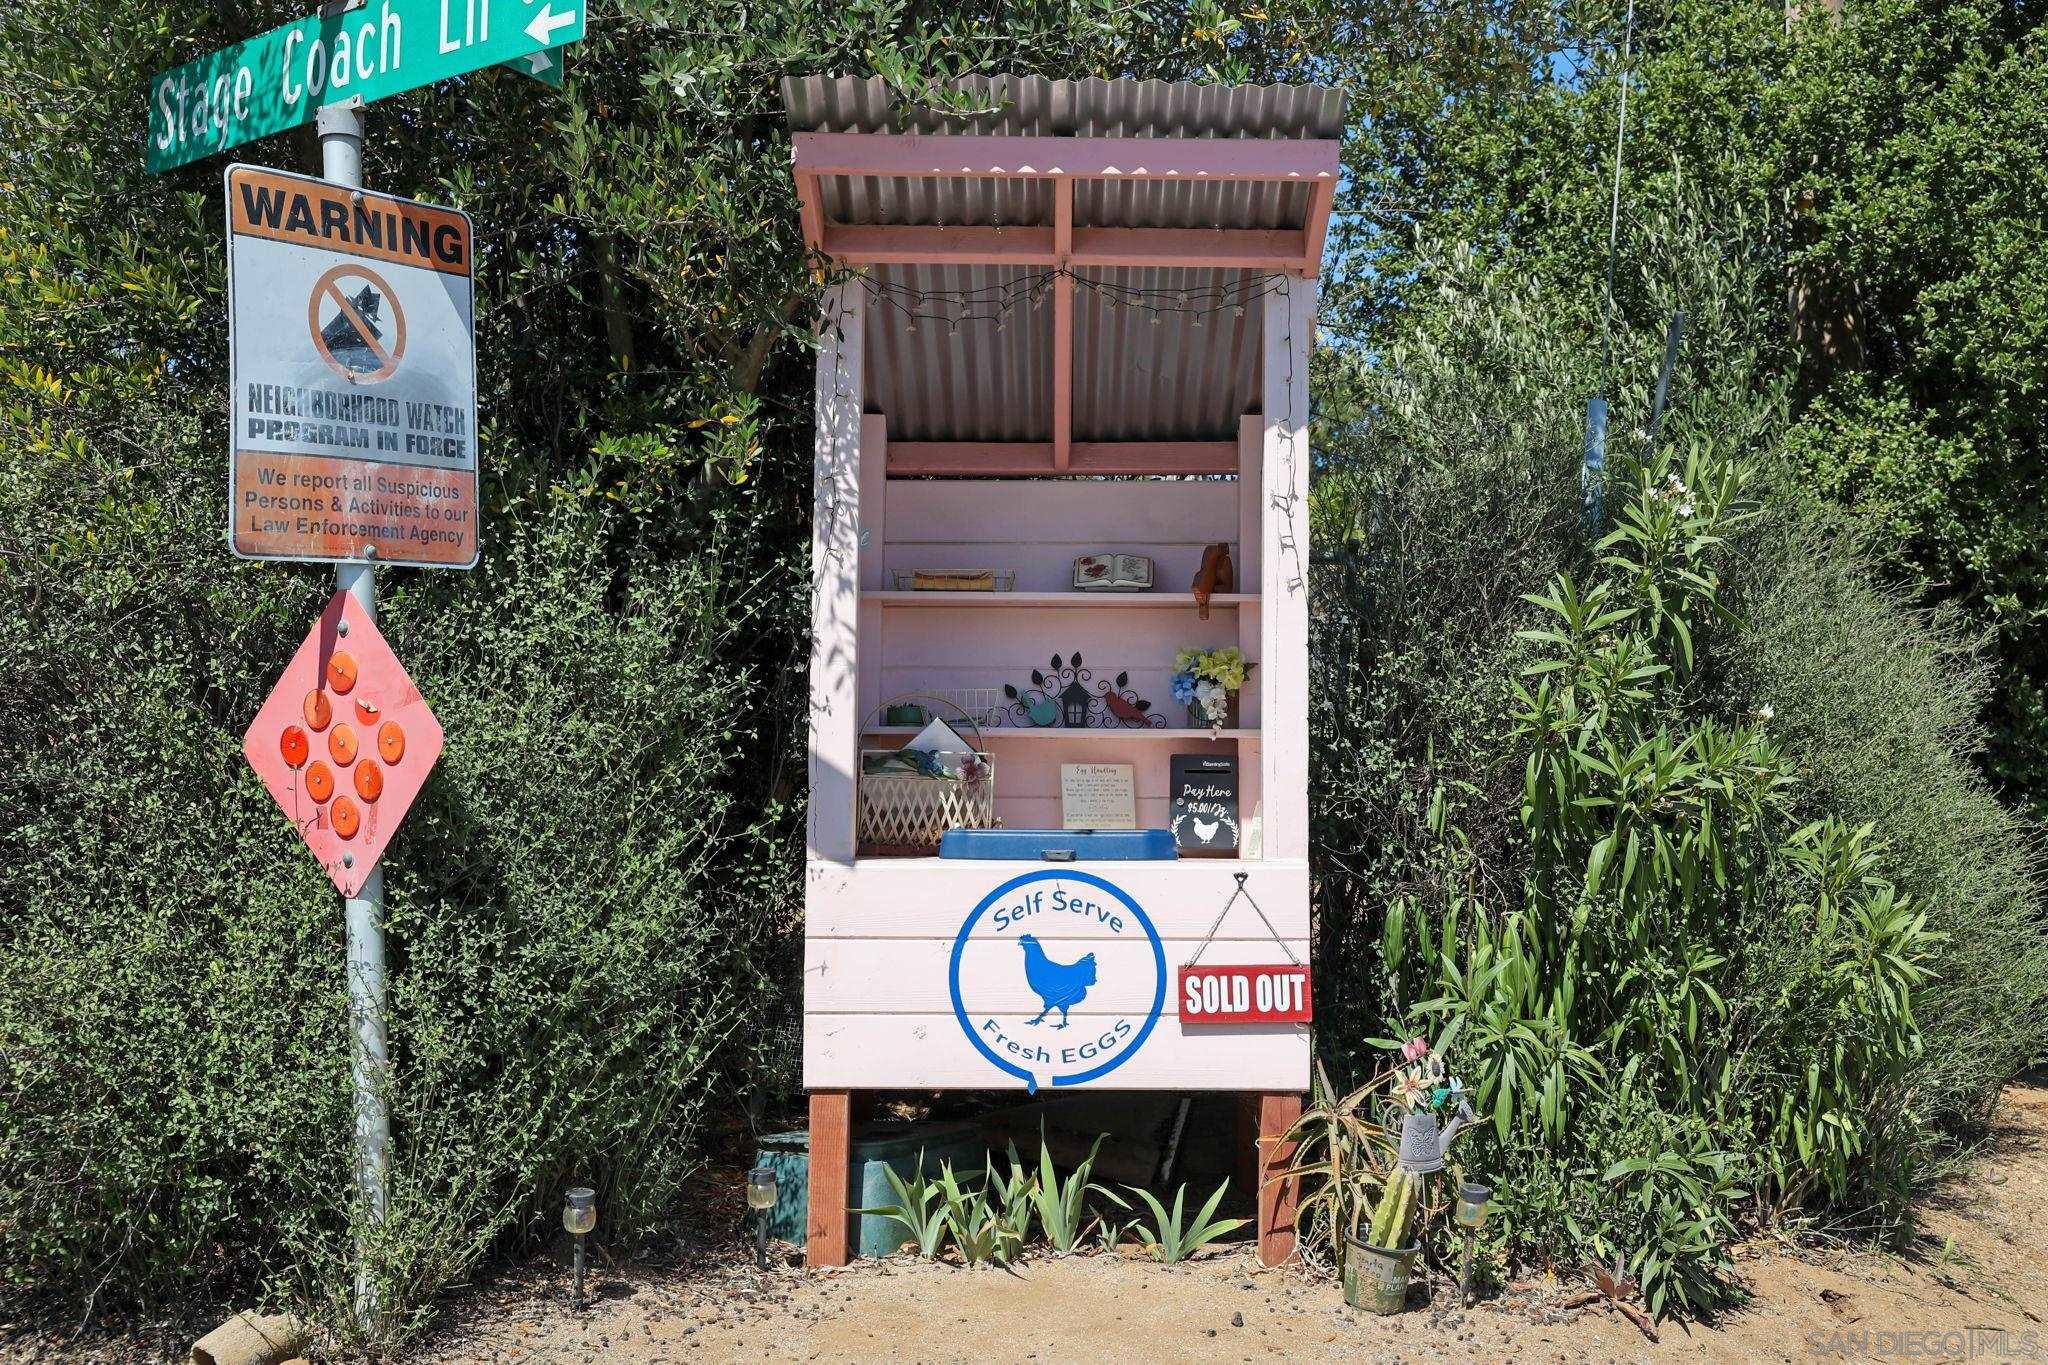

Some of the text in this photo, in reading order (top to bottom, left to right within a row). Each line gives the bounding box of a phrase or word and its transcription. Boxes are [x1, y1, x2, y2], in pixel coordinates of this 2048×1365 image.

[157, 65, 252, 150] Stage
[282, 1, 403, 105] Coach
[240, 182, 463, 265] WARNING
[248, 382, 466, 436] NEIGHBORHOOD WATCH
[248, 417, 467, 459] PROGRAM IN FORCE
[257, 467, 460, 500] We report all Suspicious
[245, 491, 469, 523] Persons & Activities to our
[251, 515, 465, 548] Law Enforcement Agency
[1183, 784, 1232, 799] Pay Here
[993, 890, 1124, 933] Self Serve
[1185, 973, 1306, 1015] SOLD OUT
[982, 1018, 1132, 1064] Fresh EGGS
